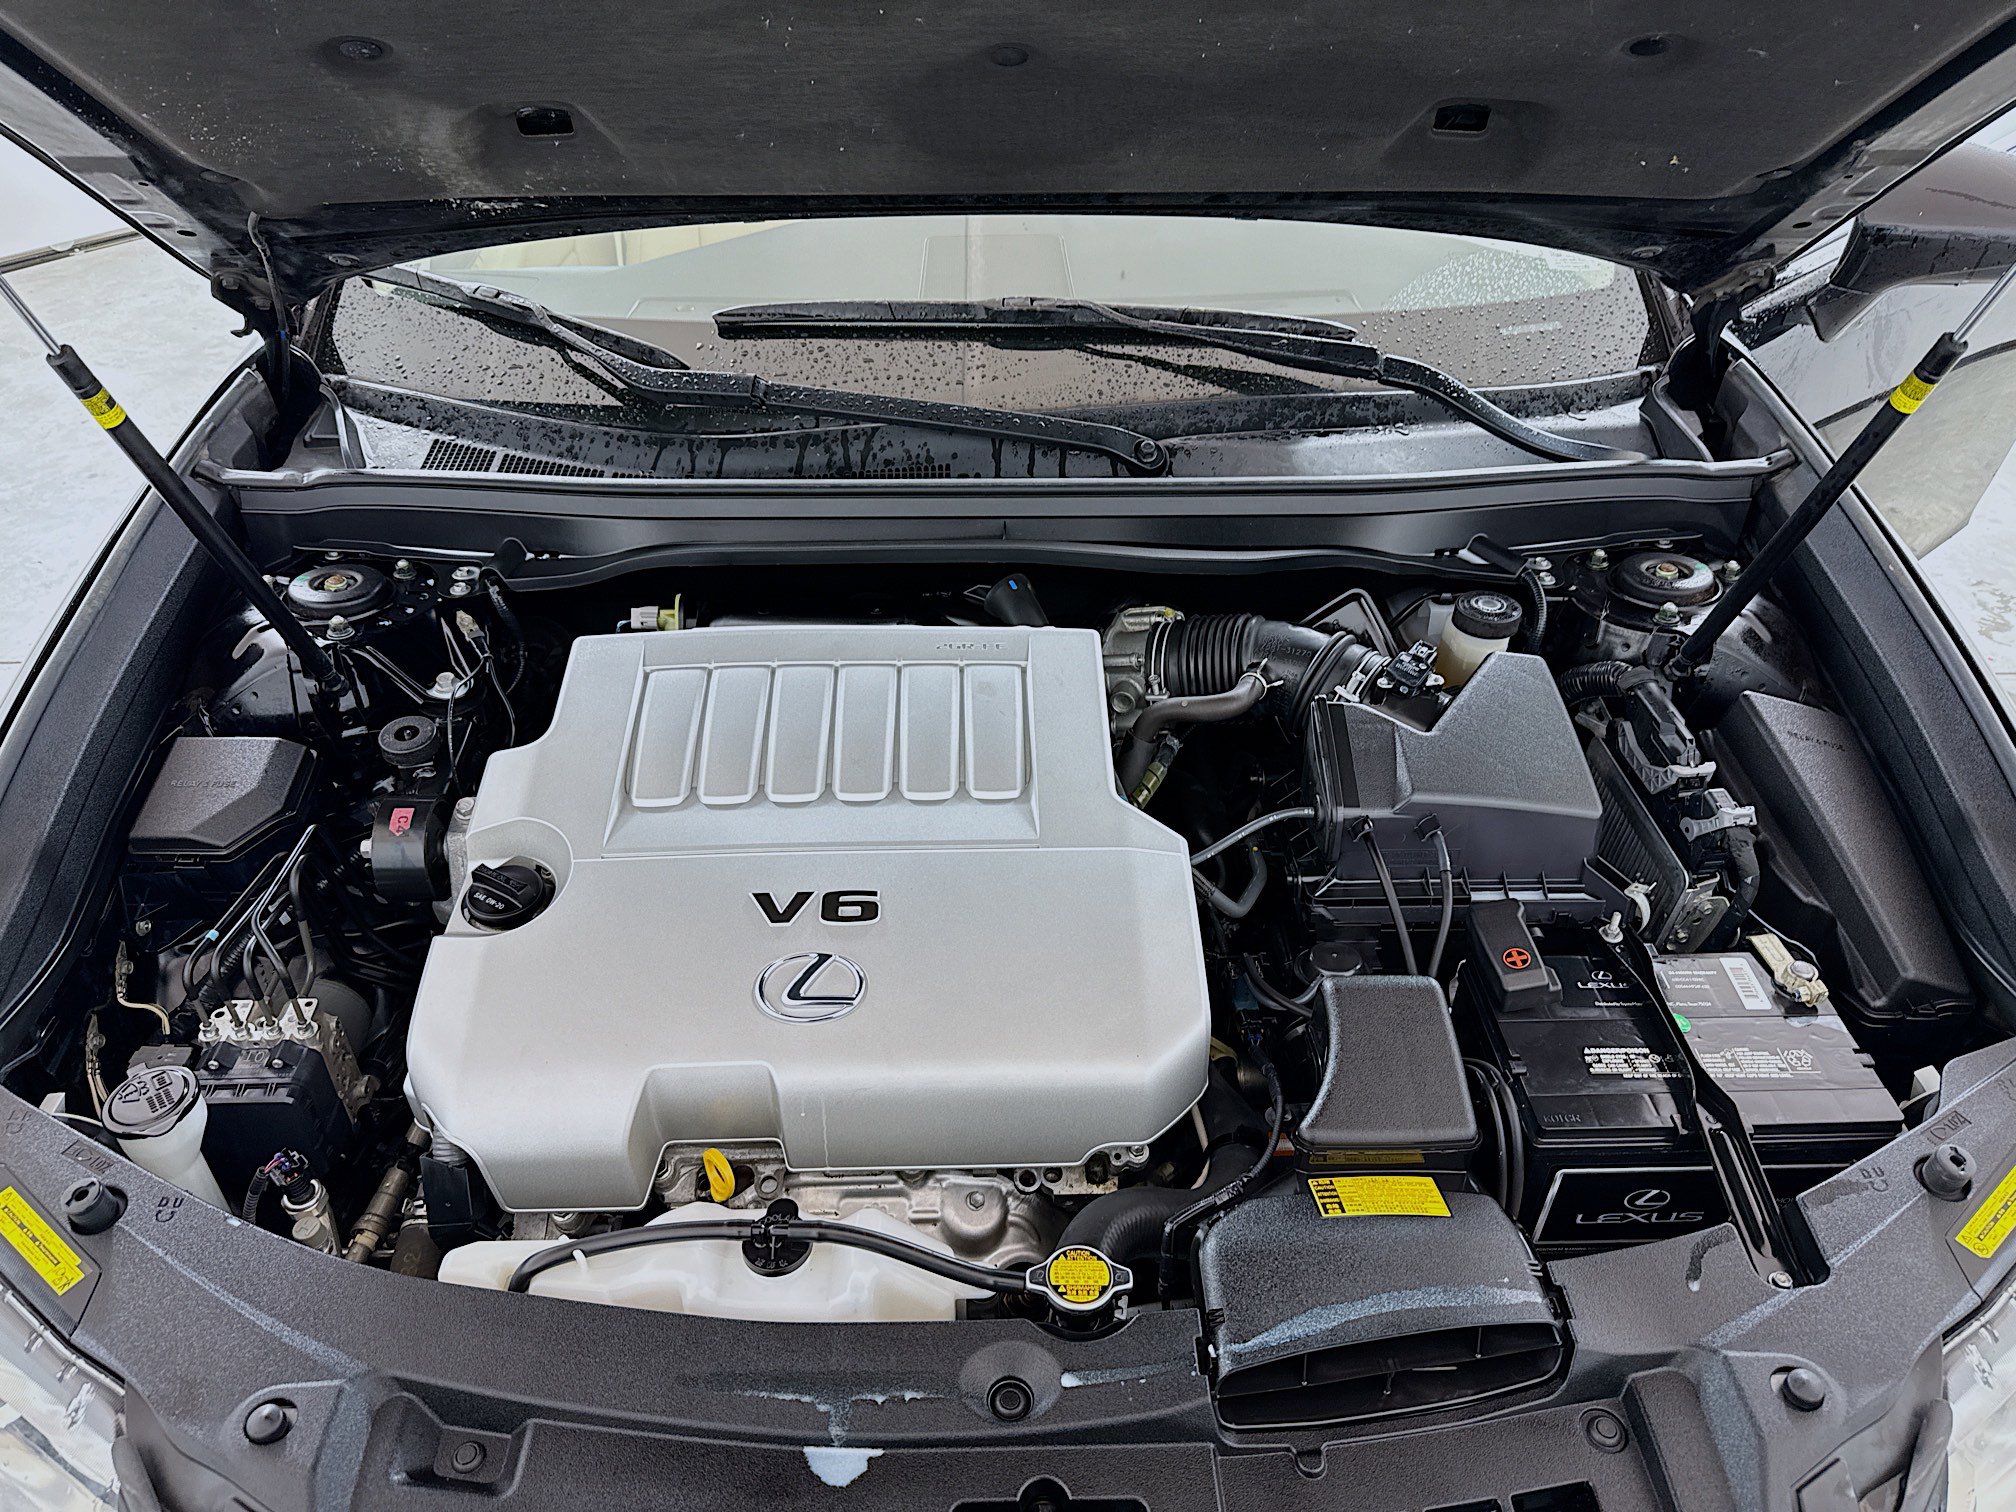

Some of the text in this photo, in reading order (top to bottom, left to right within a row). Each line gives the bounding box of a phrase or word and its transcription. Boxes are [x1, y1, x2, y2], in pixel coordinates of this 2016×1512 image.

[170, 780, 201, 788] RELAY
[210, 780, 237, 788] FUSE
[473, 891, 505, 910] SAE 0W-20
[750, 890, 881, 927] V6
[1576, 1212, 1704, 1224] LEXUS
